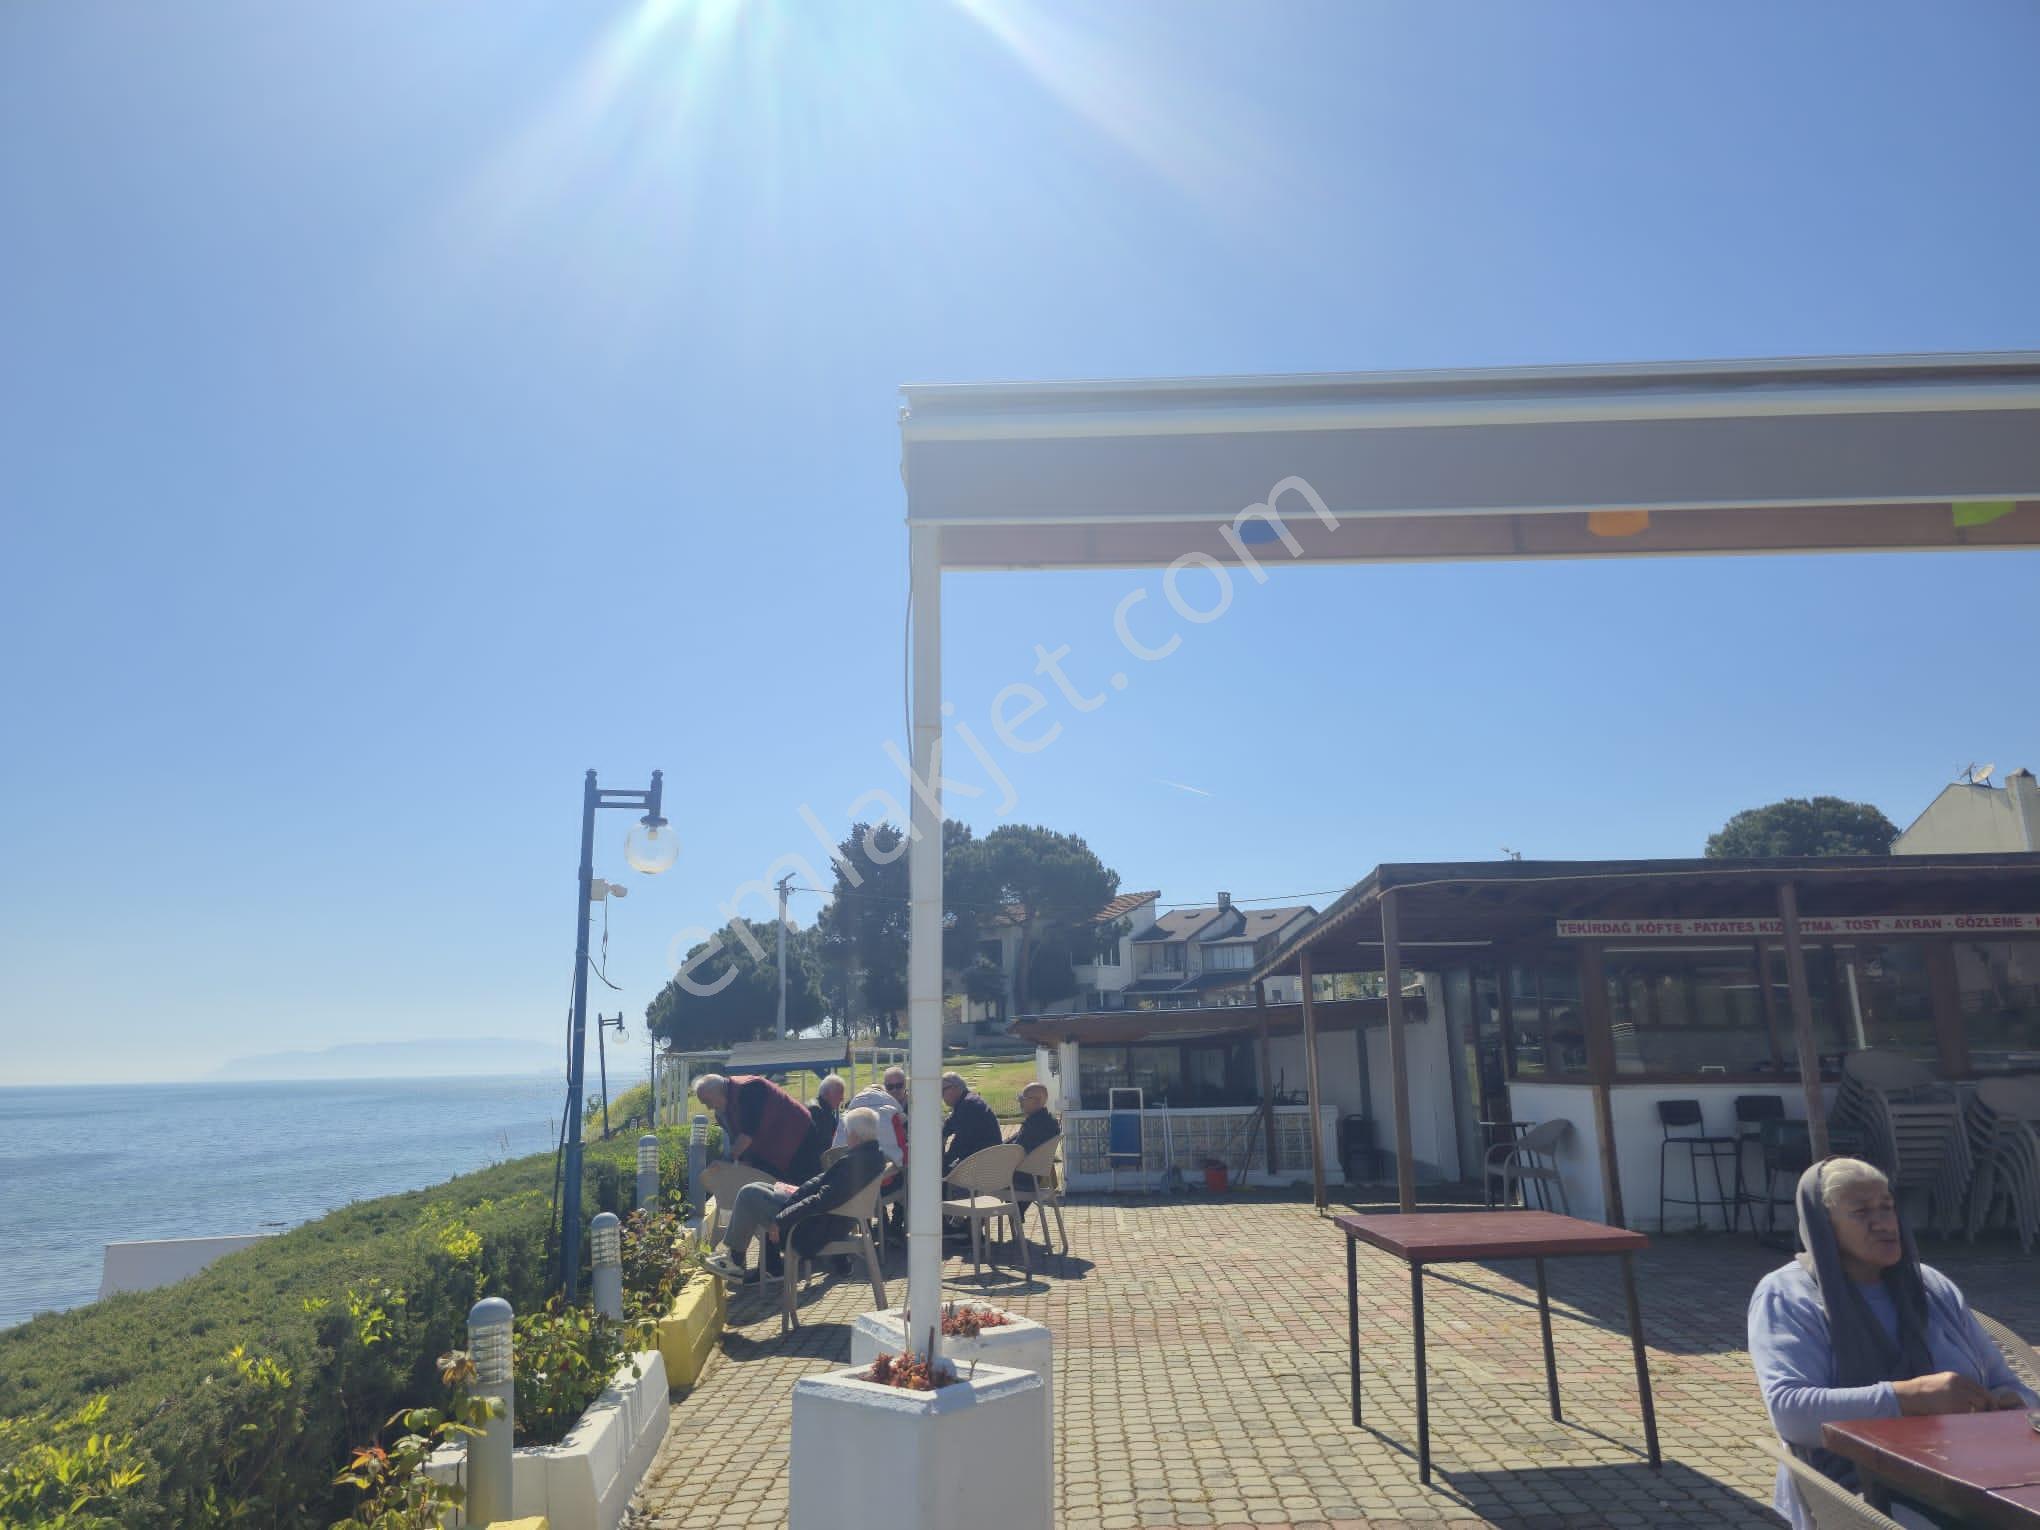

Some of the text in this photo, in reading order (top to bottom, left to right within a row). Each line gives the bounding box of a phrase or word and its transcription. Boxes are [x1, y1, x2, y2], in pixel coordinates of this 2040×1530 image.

[1636, 919, 1682, 934] KÖFTE
[1845, 918, 1881, 930] TOST
[1894, 917, 1942, 929] AYRAN
[1955, 914, 2022, 928] GÖZLEME
